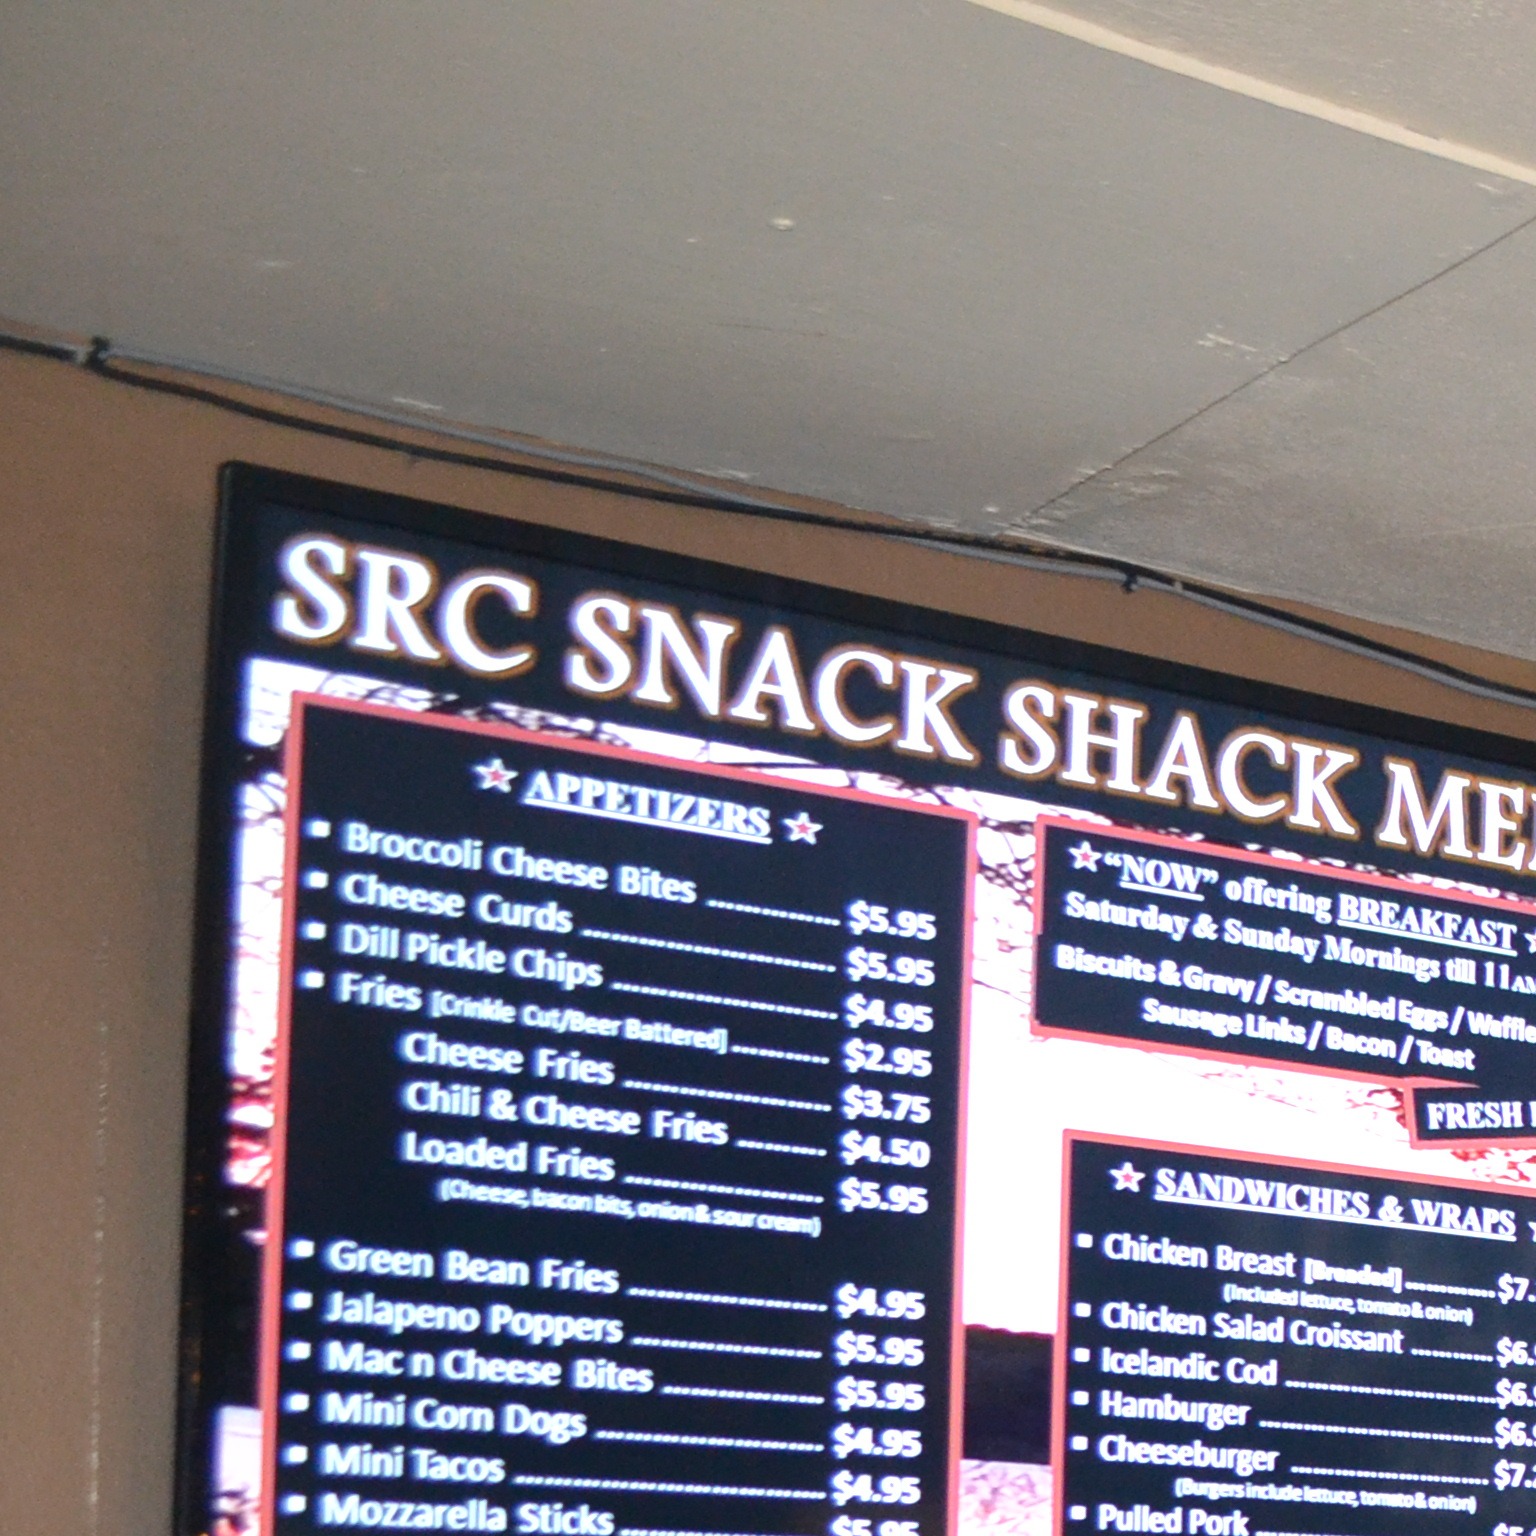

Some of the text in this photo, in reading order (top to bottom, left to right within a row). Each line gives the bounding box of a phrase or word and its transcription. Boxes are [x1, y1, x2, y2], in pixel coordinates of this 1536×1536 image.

[279, 540, 531, 671] SRC
[569, 598, 974, 760] SNACK
[1003, 686, 1355, 835] SHACK
[522, 772, 772, 840] APPETIZERS
[344, 822, 936, 940] Broccoli Cheese Bites $5.95
[1225, 876, 1333, 920] offering
[1338, 895, 1517, 949] BREAKFAST
[340, 874, 935, 986] Cheese Curds $5.95
[340, 923, 933, 1032] Dill Pickle Chips $4.95
[1427, 1101, 1524, 1130] FRESH
[1155, 1171, 1516, 1234] SANDWICHES & WRAPS
[326, 1240, 925, 1320] Green Bean Fries $4.95
[325, 1291, 924, 1366] Jalapeno Poppers $5.95
[1101, 1302, 1206, 1336] Chicken
[1213, 1312, 1284, 1343] Salad
[1289, 1320, 1405, 1354] Croissant
[1102, 1347, 1220, 1381] Icelandic
[1226, 1357, 1277, 1386] Cod
[1100, 1390, 1251, 1431] Hamburger
[1098, 1434, 1280, 1476] Cheeseburger
[1098, 1504, 1182, 1533] Pulled
[1189, 1509, 1249, 1536] Pork
